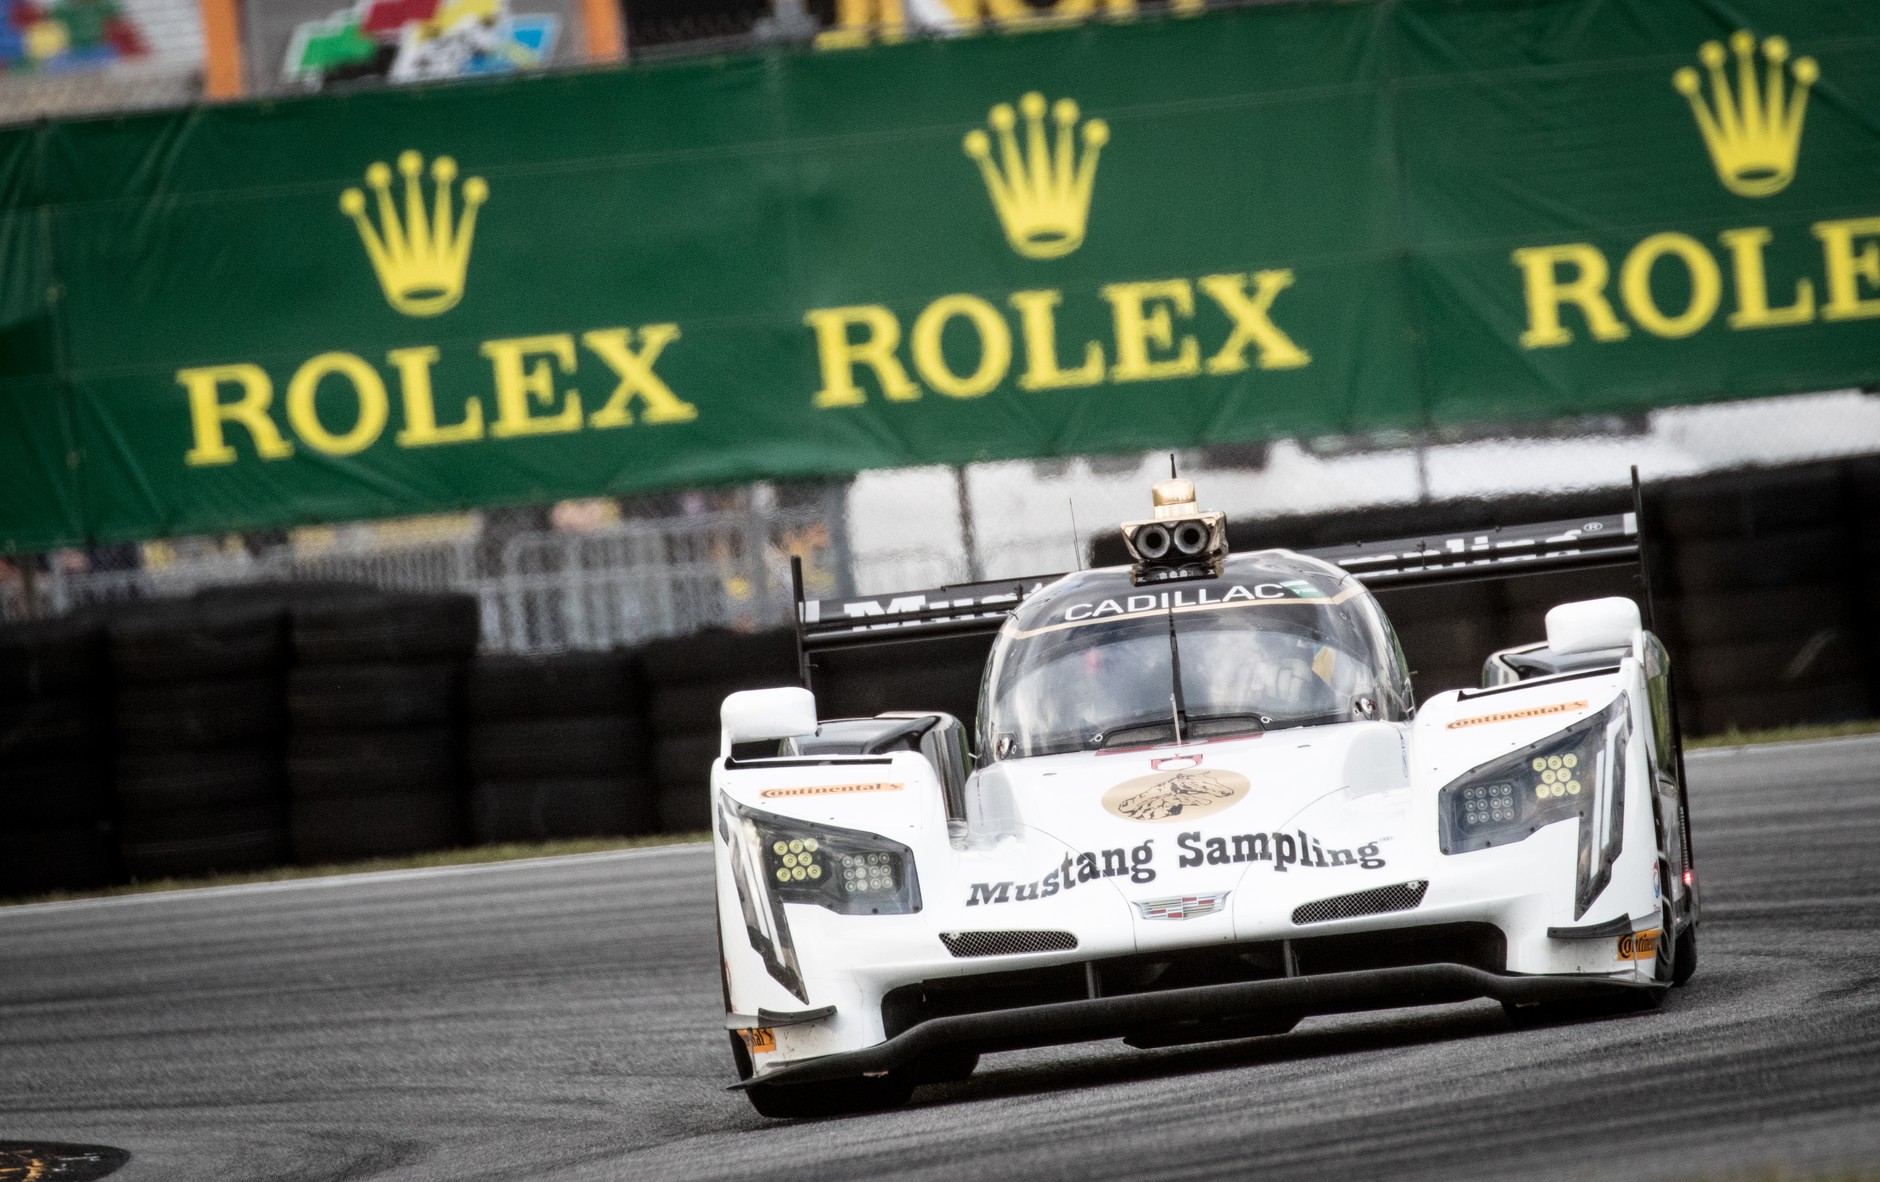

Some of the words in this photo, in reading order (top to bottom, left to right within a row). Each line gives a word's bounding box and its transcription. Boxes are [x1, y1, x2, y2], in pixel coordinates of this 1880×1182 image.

[803, 268, 1312, 408] ROLEX
[175, 322, 698, 467] ROLEX
[1064, 583, 1285, 621] CADILLAC
[1447, 704, 1566, 729] Continental
[761, 783, 881, 798] Continental
[965, 839, 1157, 907] Mustang
[1177, 828, 1388, 872] Sampling
